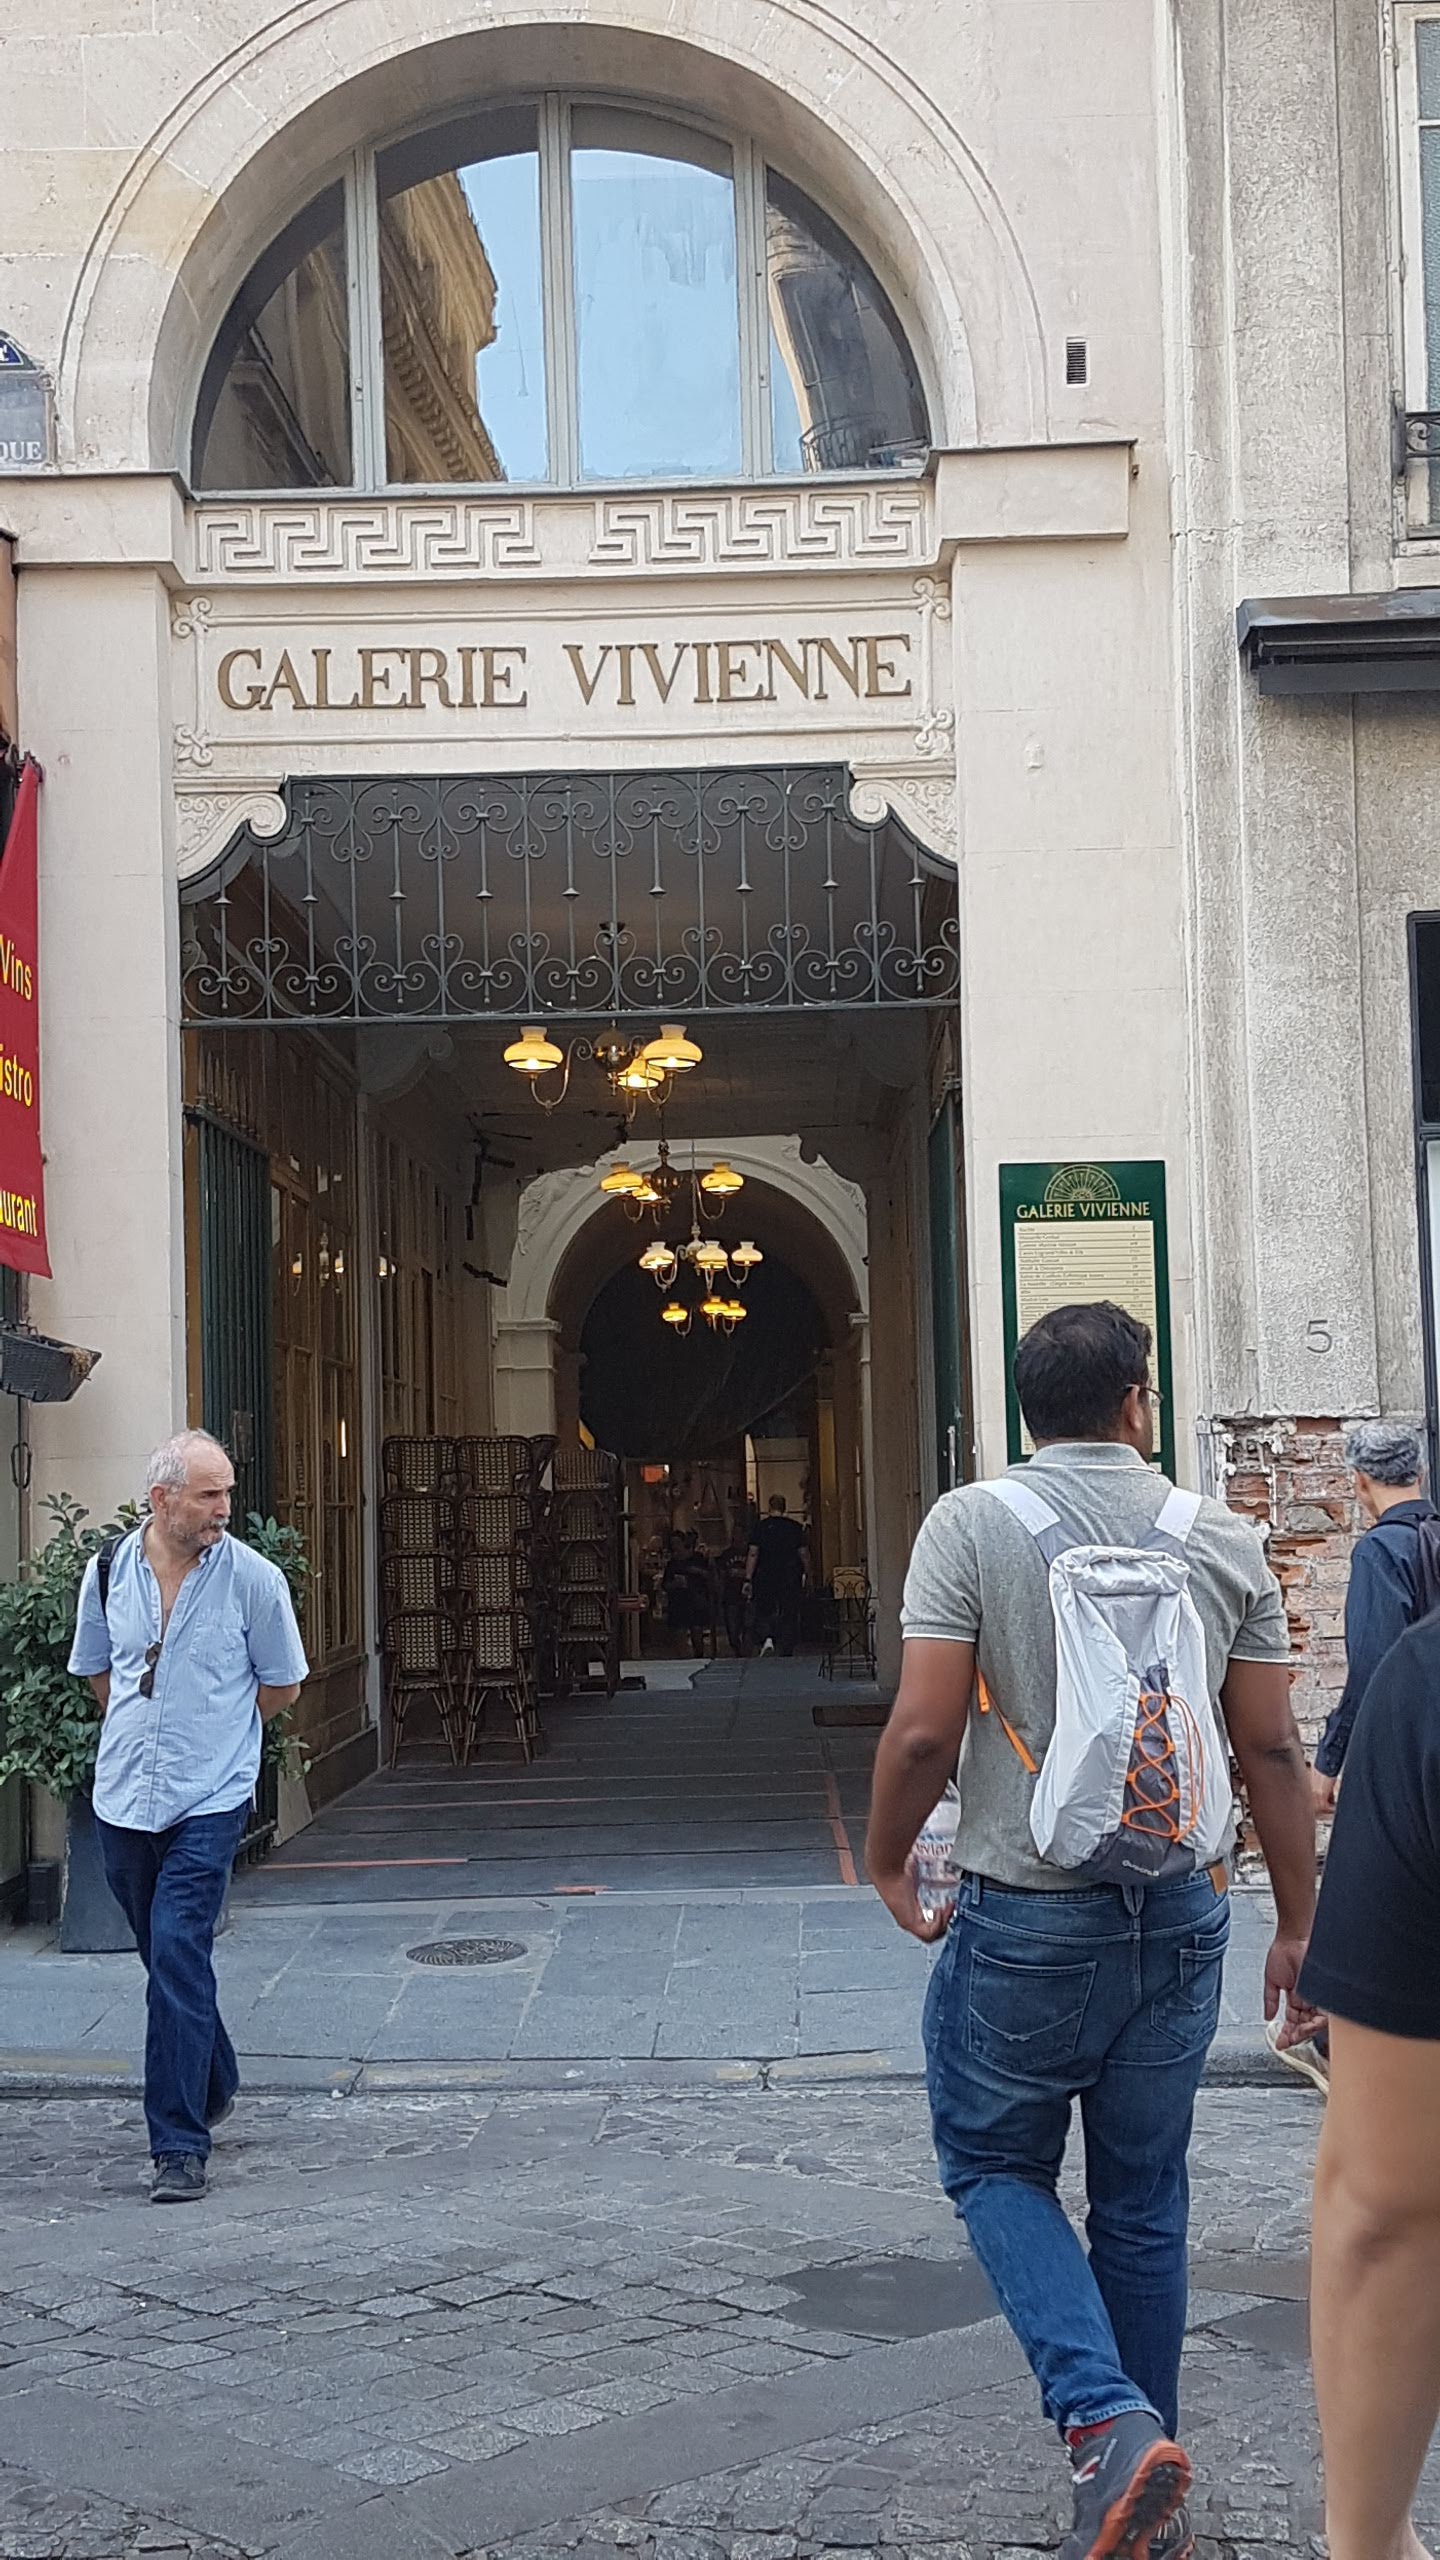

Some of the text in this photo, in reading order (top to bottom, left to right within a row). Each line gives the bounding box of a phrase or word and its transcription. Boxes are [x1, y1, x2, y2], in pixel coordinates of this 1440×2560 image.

[217, 633, 912, 710] GALERIE VIVIENNE
[0, 934, 32, 1000] Vins
[1016, 1201, 1151, 1219] GALERIE VIVIENNE
[1306, 1319, 1333, 1354] 5
